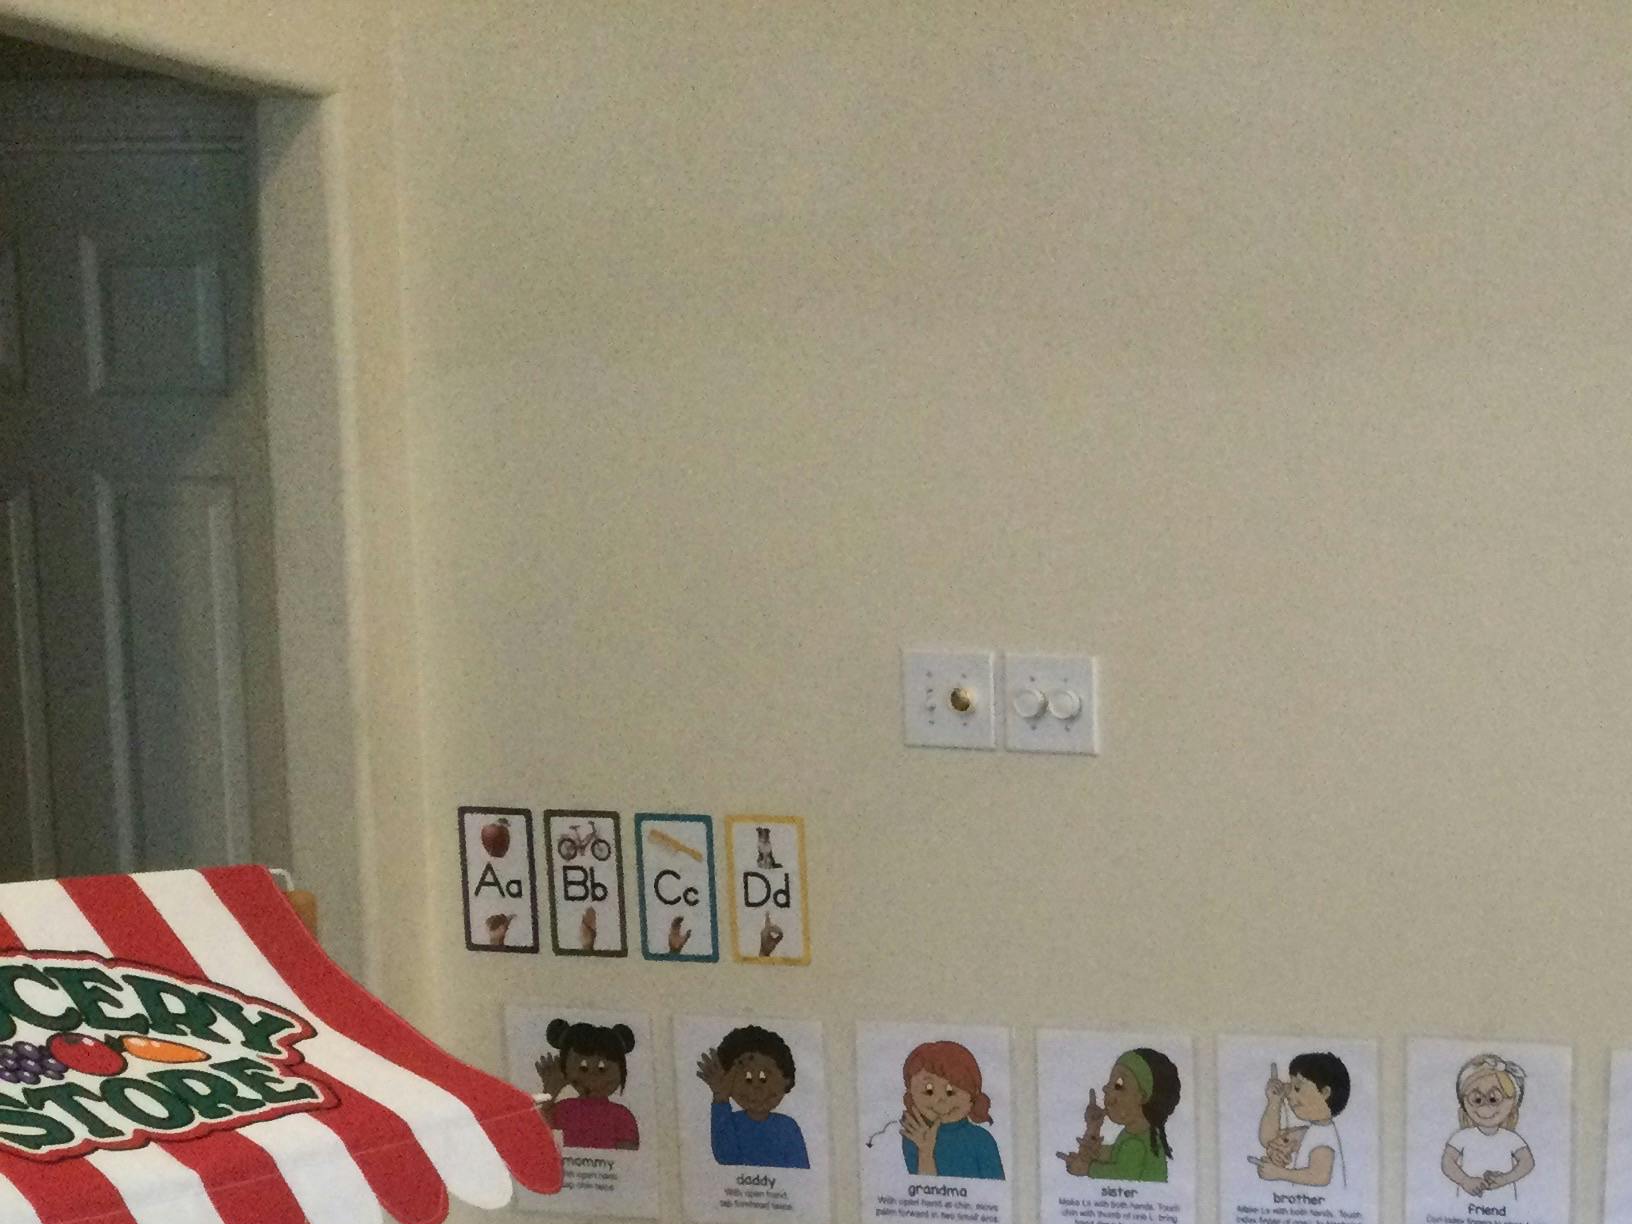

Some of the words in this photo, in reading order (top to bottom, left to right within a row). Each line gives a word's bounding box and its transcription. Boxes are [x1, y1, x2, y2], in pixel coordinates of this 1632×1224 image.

[474, 862, 523, 899] Aa
[562, 865, 609, 902] Bb
[653, 869, 700, 906] Cc
[743, 871, 791, 909] Dd
[0, 964, 296, 1055] CERY
[0, 1057, 319, 1150] STORE
[562, 1157, 614, 1172] mommy
[736, 1173, 776, 1189] daddy
[908, 1184, 968, 1198] grandma
[1101, 1186, 1138, 1198] sister
[1273, 1192, 1325, 1206] brother
